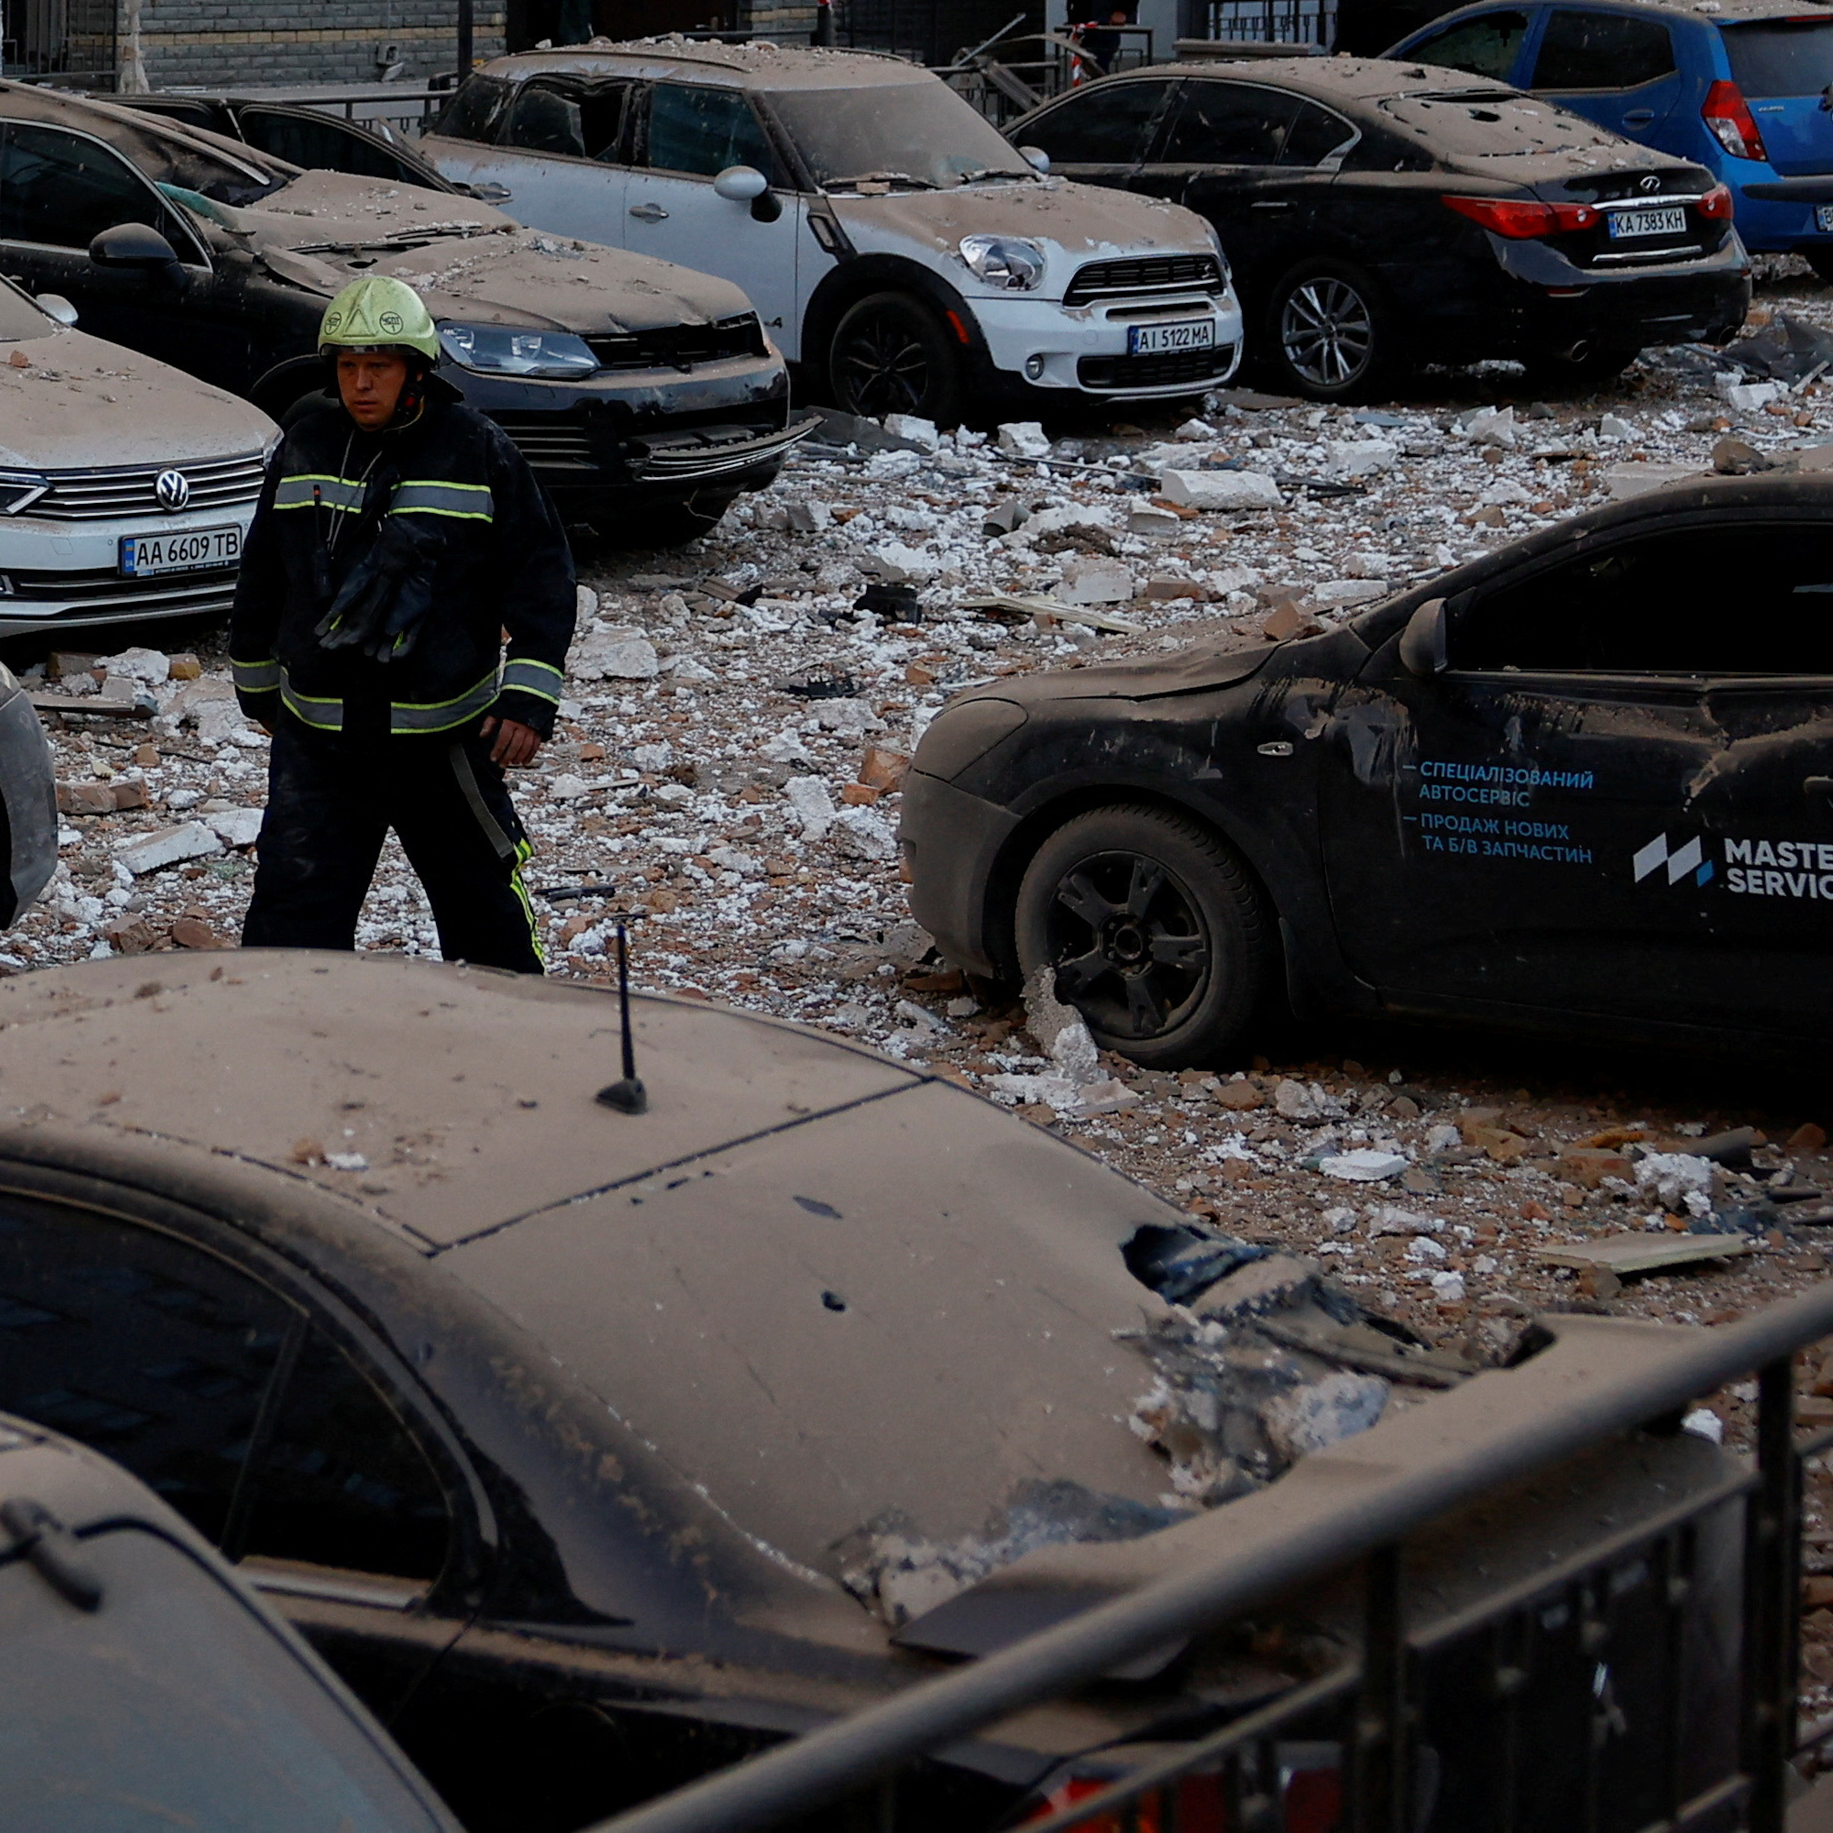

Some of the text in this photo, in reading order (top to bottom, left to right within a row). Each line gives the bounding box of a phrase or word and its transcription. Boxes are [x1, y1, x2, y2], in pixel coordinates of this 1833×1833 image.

[1161, 327, 1190, 348] 5122
[1192, 325, 1210, 345] MA
[136, 532, 238, 566] AA 6609 TB
[1420, 760, 1594, 790] СПЕЦІАЛІЗОВАНИЙ
[1419, 783, 1531, 808] АВТОСЕРВІС
[1421, 812, 1569, 841] ПРОДАЖ НОВИХ
[1421, 835, 1593, 864] ТА Б/В ЗАПЧАСТИН
